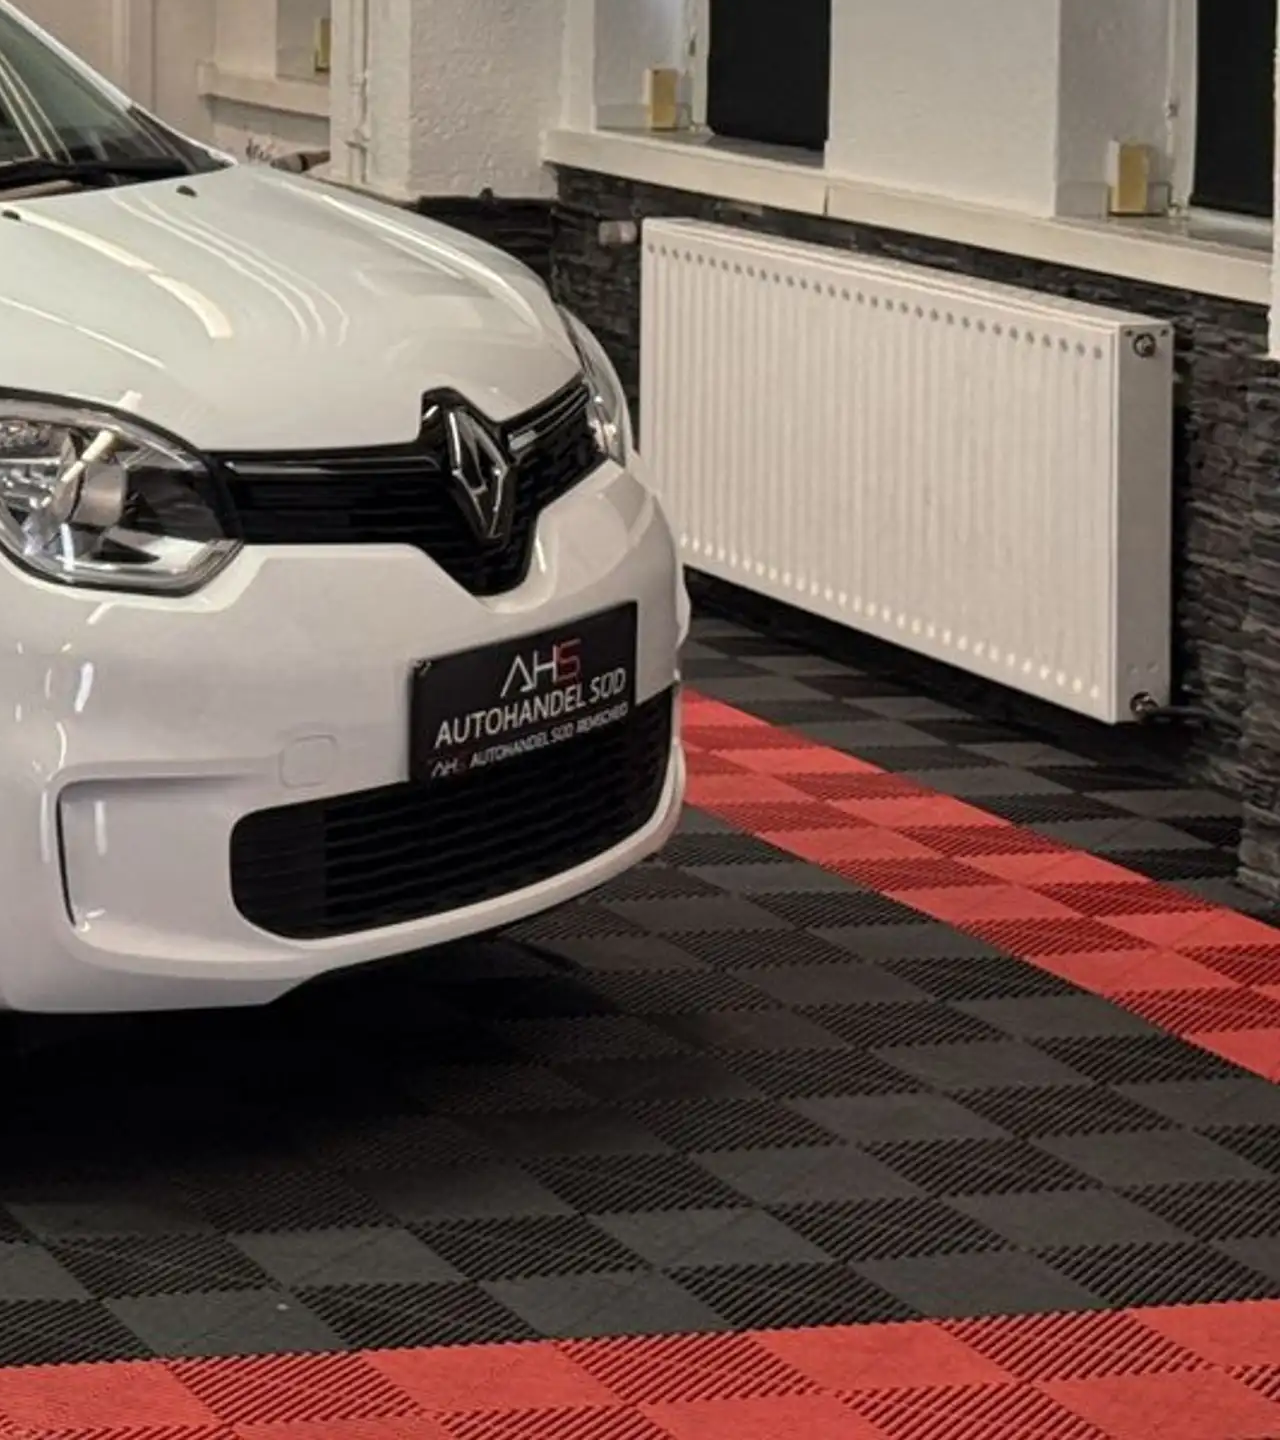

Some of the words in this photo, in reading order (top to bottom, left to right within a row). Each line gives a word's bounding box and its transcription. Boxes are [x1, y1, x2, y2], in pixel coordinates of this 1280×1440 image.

[500, 637, 581, 697] AHS
[435, 682, 586, 749] AUTOHANDEL
[589, 667, 626, 703] SÜD
[469, 731, 549, 768] AUTOHANDEL
